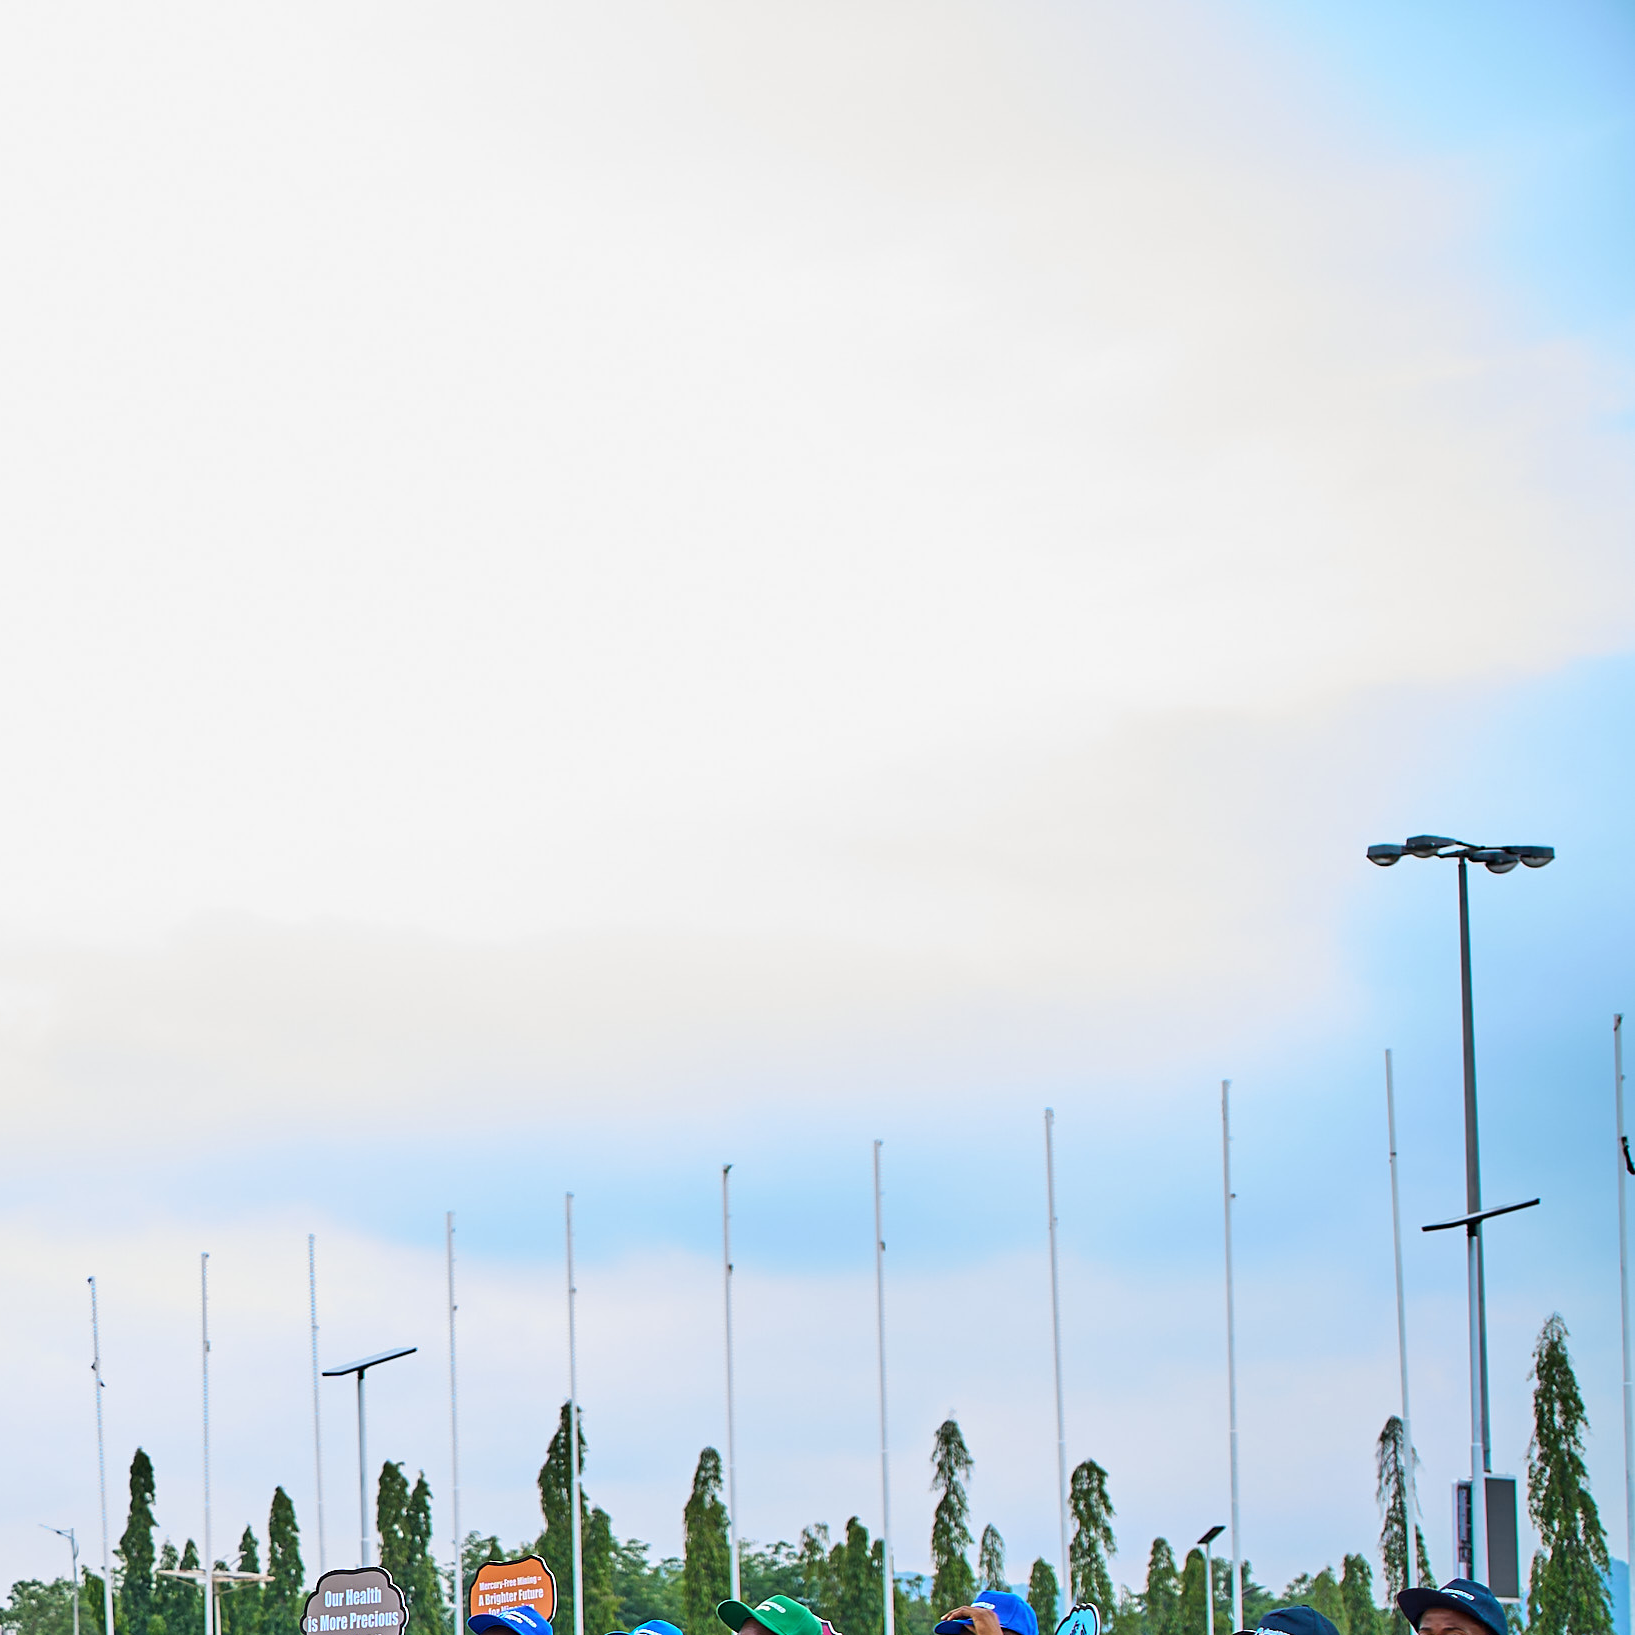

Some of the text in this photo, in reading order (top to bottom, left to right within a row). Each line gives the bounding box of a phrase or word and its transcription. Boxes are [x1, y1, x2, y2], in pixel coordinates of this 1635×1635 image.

[479, 1576, 537, 1591] Mercury-Free Mining
[325, 1587, 381, 1608] Our Health
[479, 1588, 543, 1606] A Brighter Future
[307, 1610, 399, 1633] is More Precious
